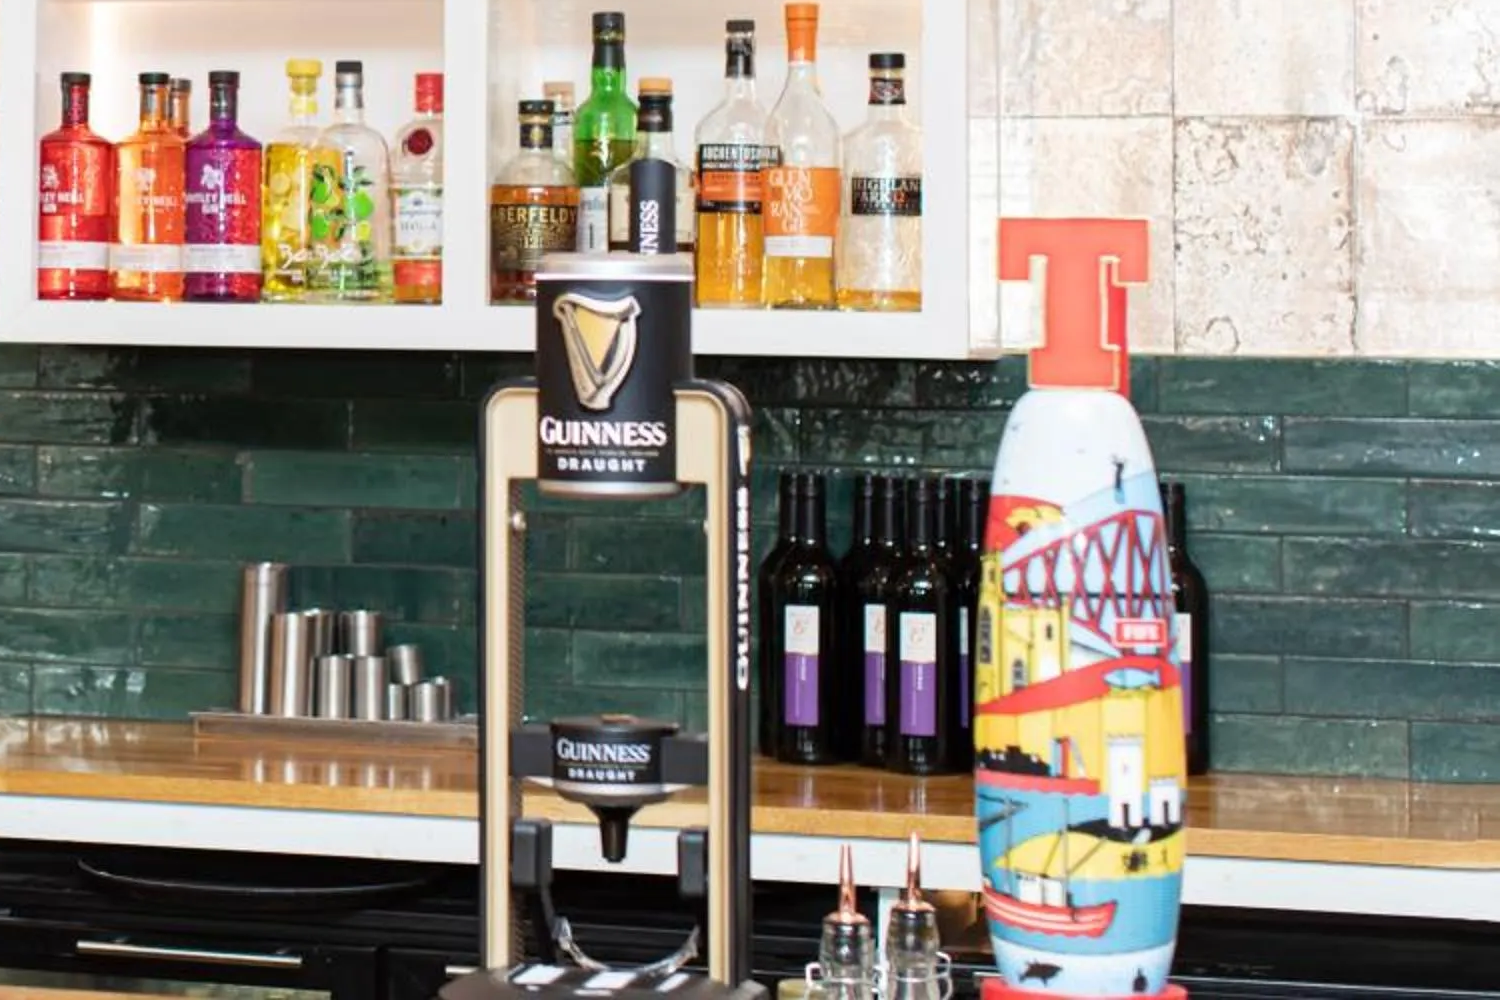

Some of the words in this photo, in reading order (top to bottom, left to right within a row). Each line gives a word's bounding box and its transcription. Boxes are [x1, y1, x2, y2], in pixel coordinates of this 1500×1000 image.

[540, 415, 668, 447] GUINNESS
[556, 457, 647, 473] DRAUGHT
[556, 737, 652, 764] GUINNESS
[567, 767, 636, 781] DRAUGHT
